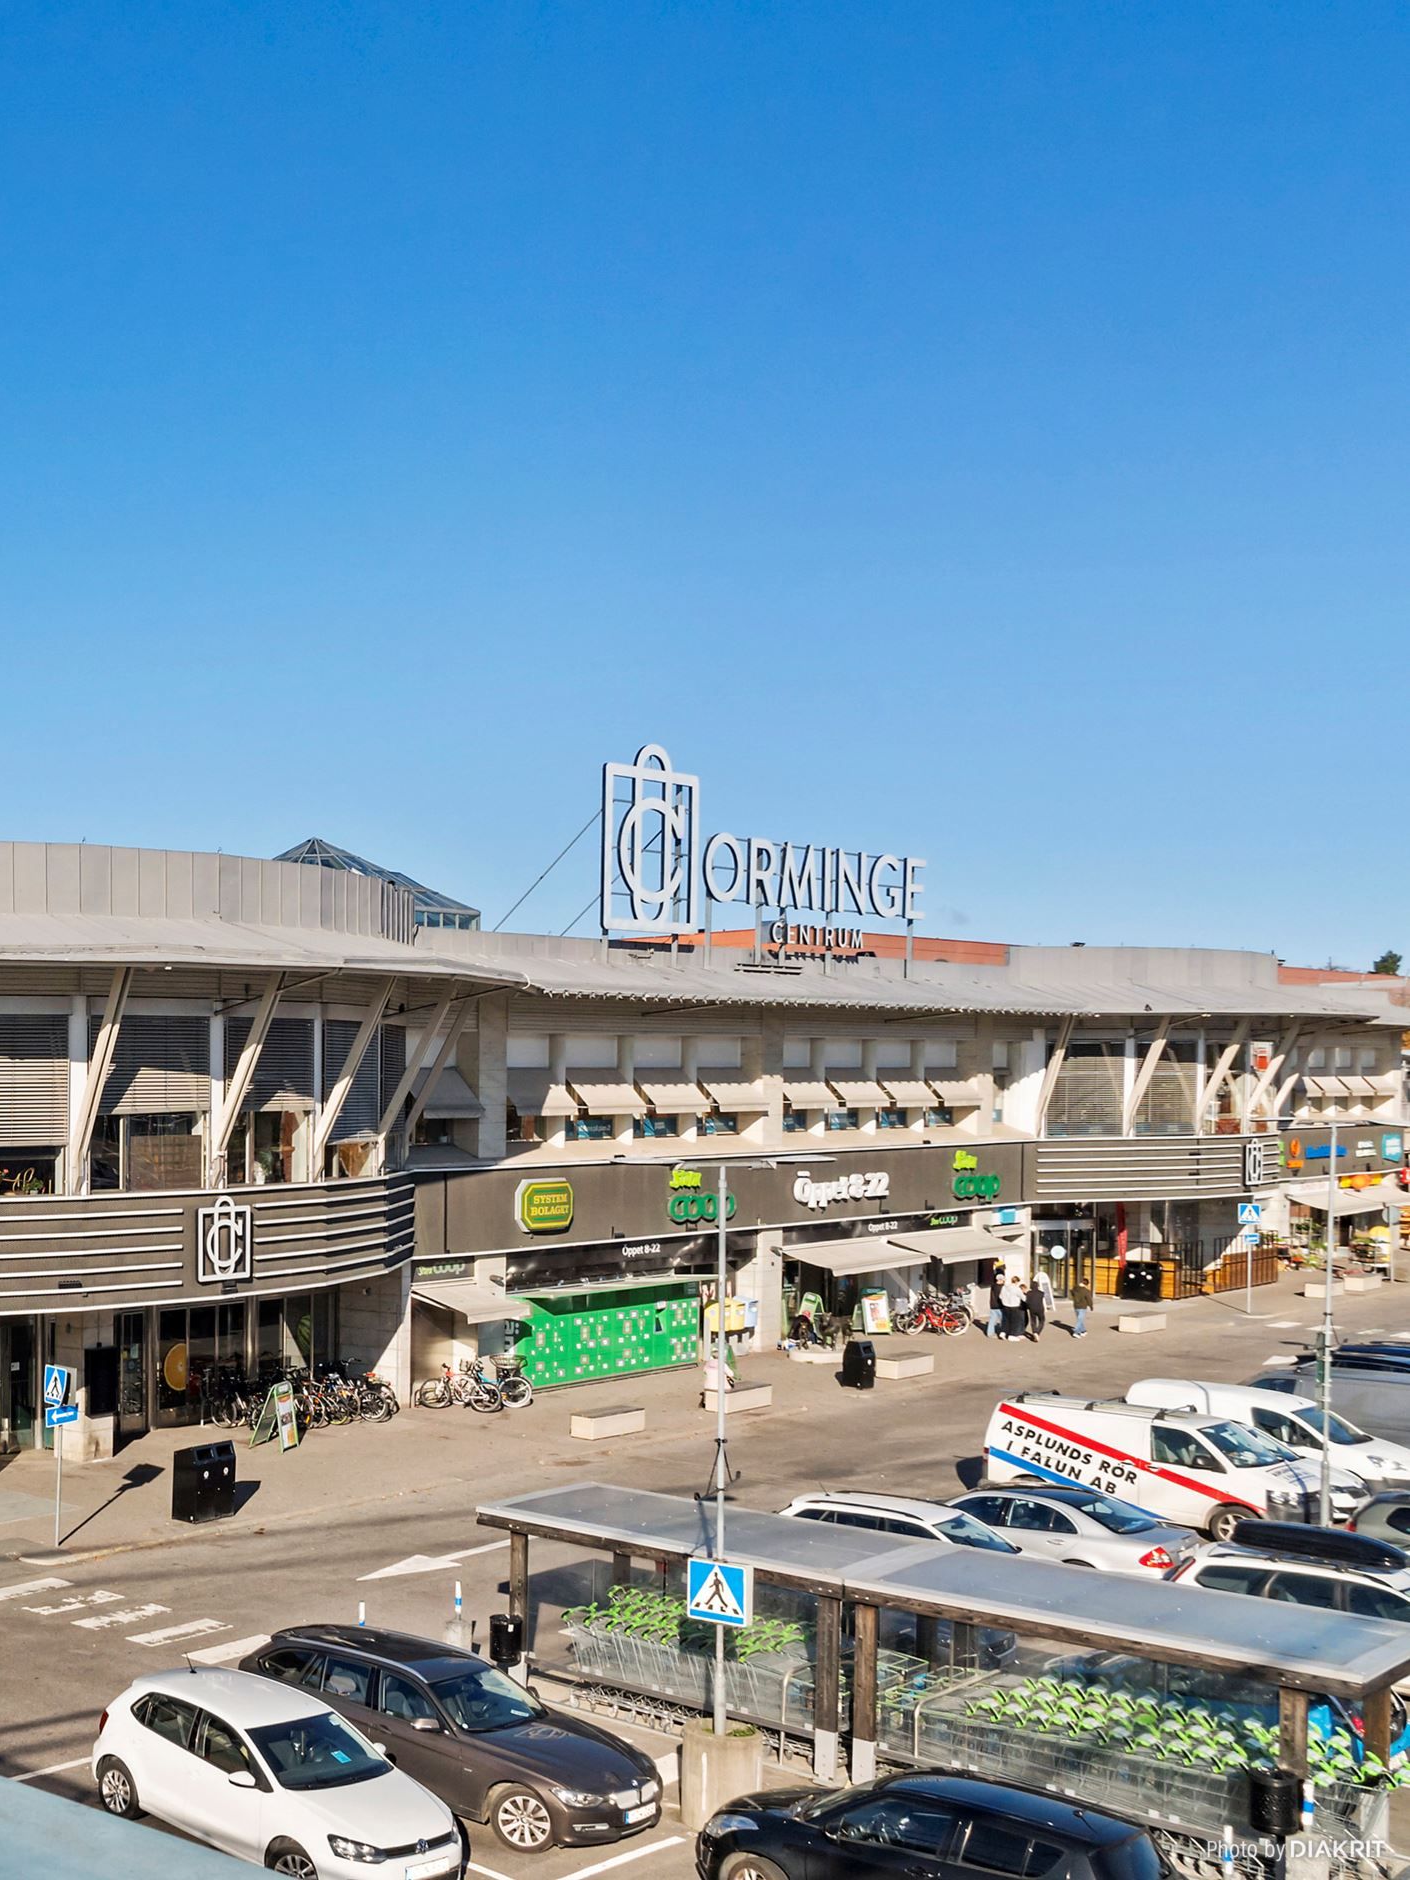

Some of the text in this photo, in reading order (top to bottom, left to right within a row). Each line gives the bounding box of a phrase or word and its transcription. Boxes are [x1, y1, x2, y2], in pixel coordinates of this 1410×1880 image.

[703, 832, 927, 920] ORMINGE
[770, 921, 863, 949] CENTRUM
[533, 1194, 567, 1204] SYSTEM
[793, 1171, 890, 1208] Öppet 8-22
[531, 1205, 569, 1216] BOLAGET
[622, 1243, 661, 1258] Öppet 8-22
[1001, 1420, 1138, 1485] ASPLUNDS RÖR
[1005, 1440, 1118, 1494] I FALUN AB
